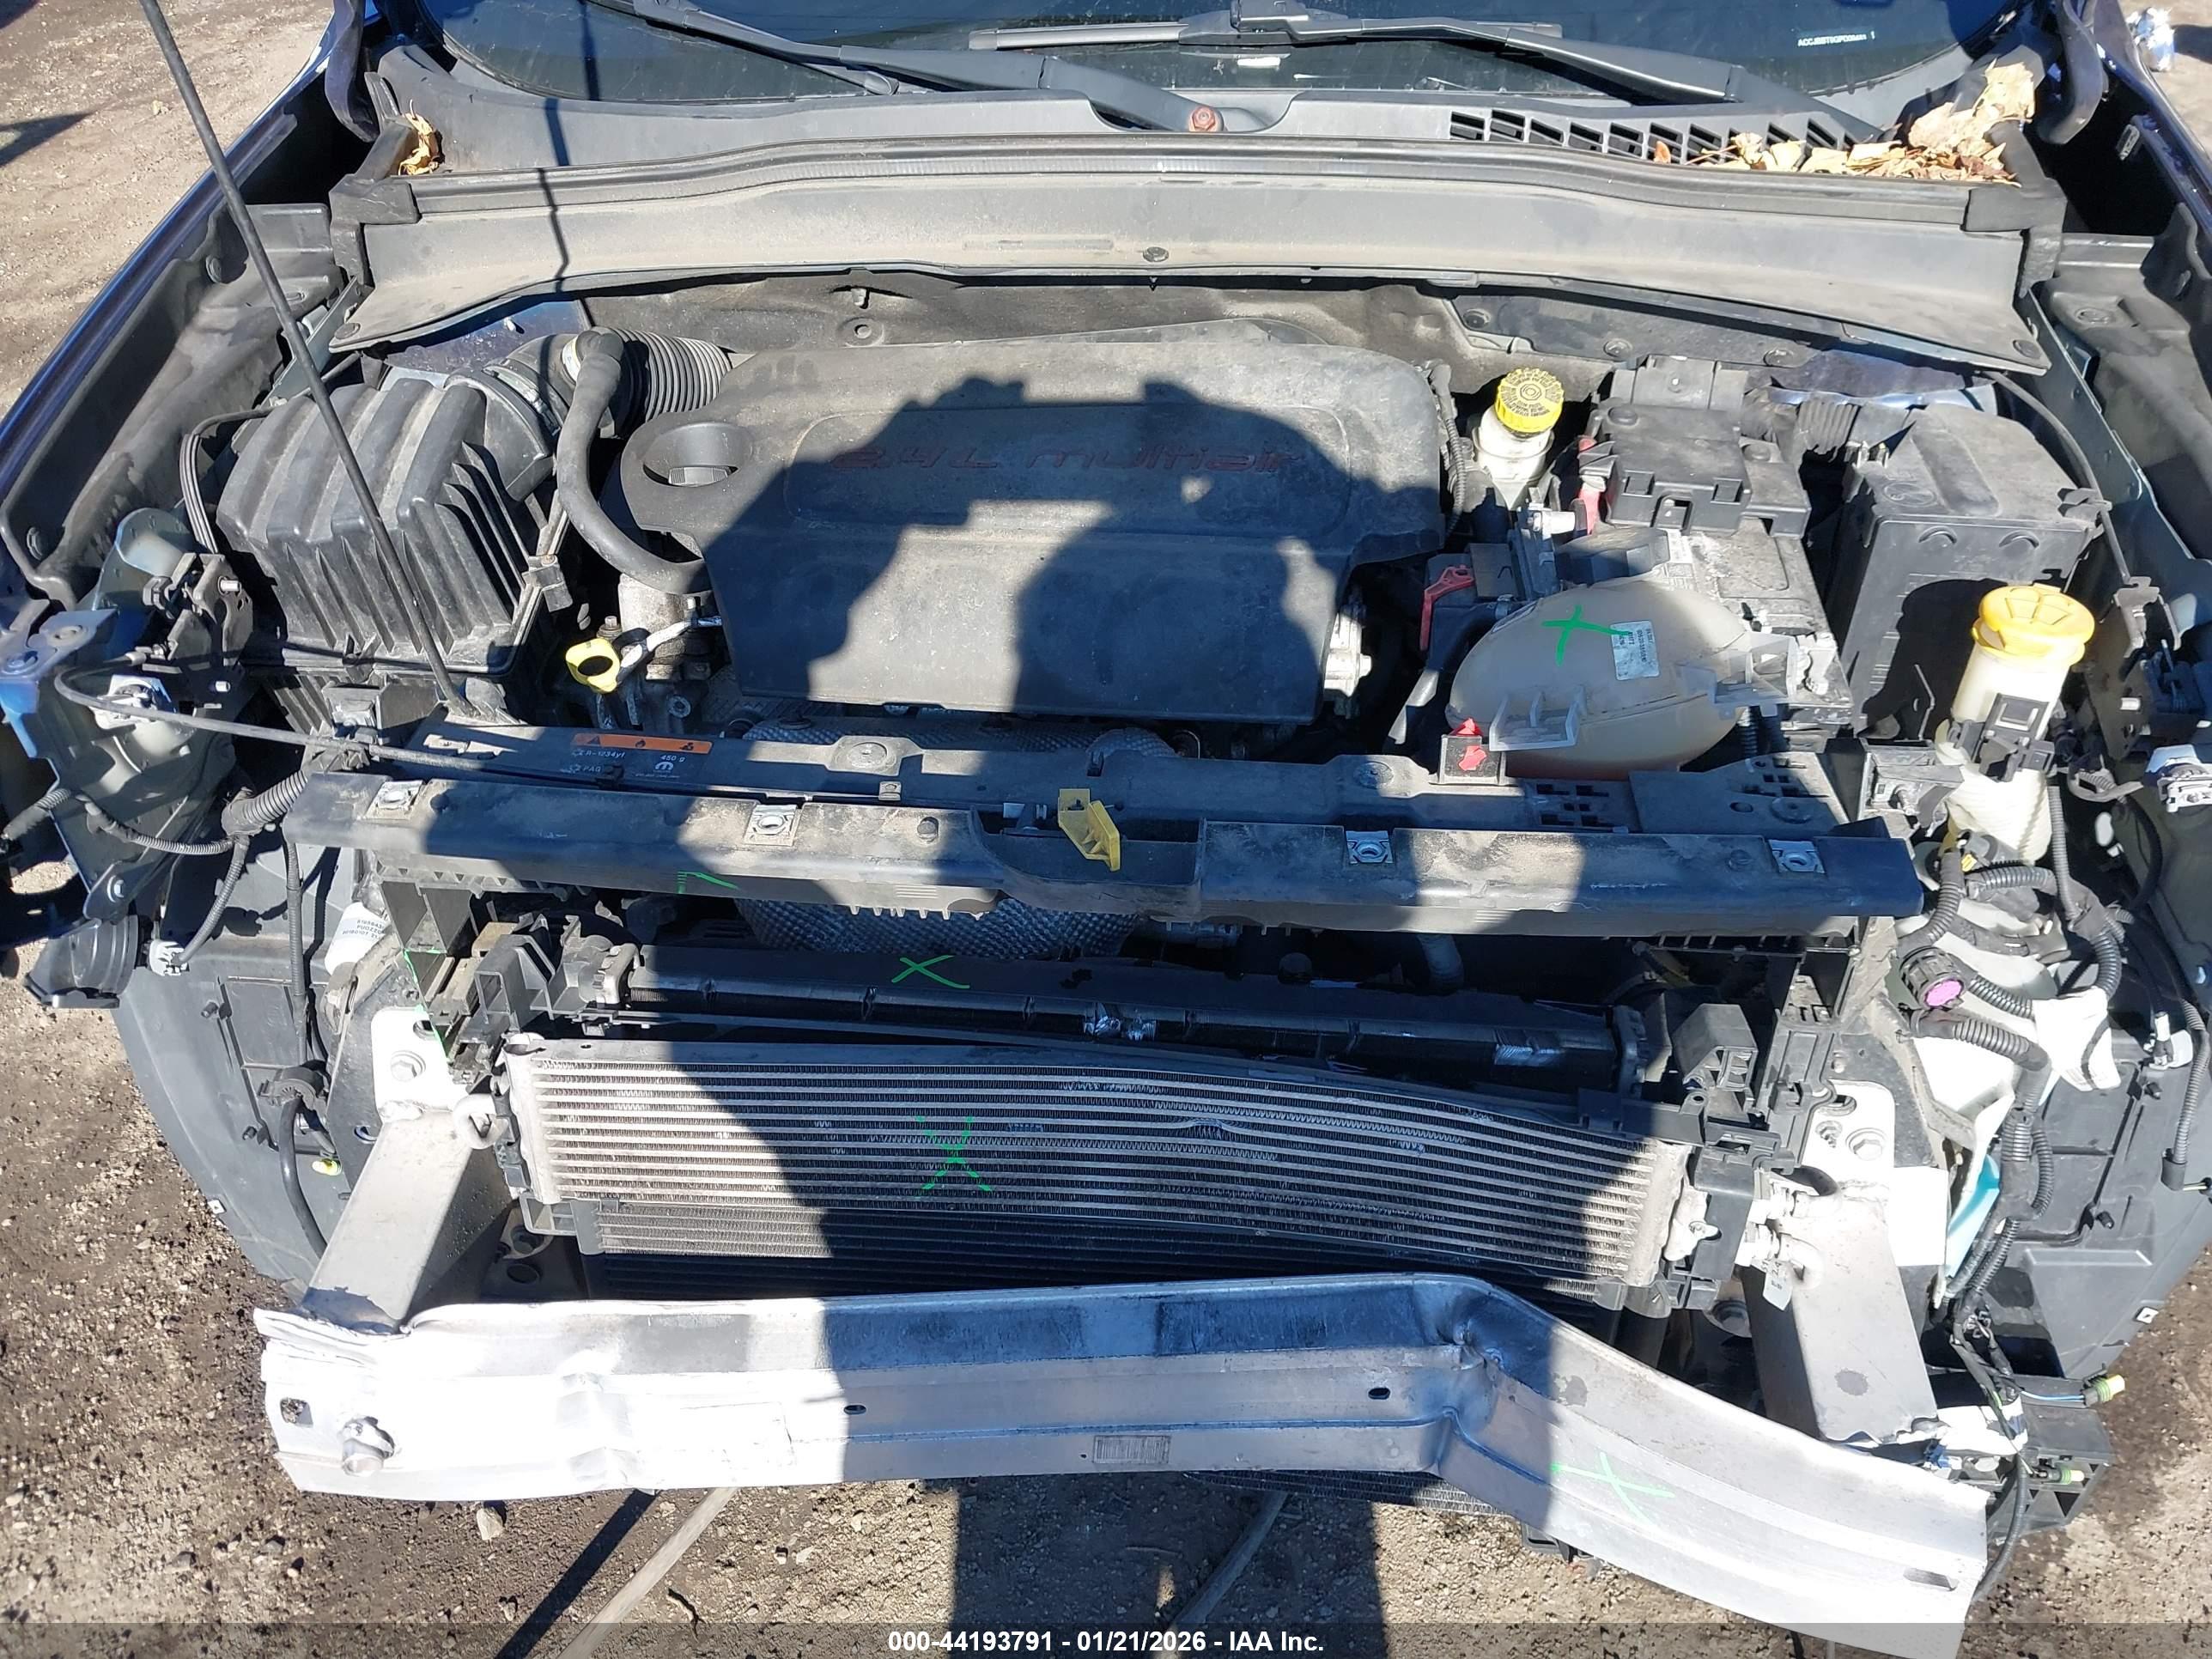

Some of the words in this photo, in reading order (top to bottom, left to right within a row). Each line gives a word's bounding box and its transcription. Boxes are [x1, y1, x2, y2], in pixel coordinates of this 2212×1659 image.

[830, 446, 998, 469] 2.4L
[1026, 444, 1302, 473] multiair
[585, 749, 626, 759] R-1234yf
